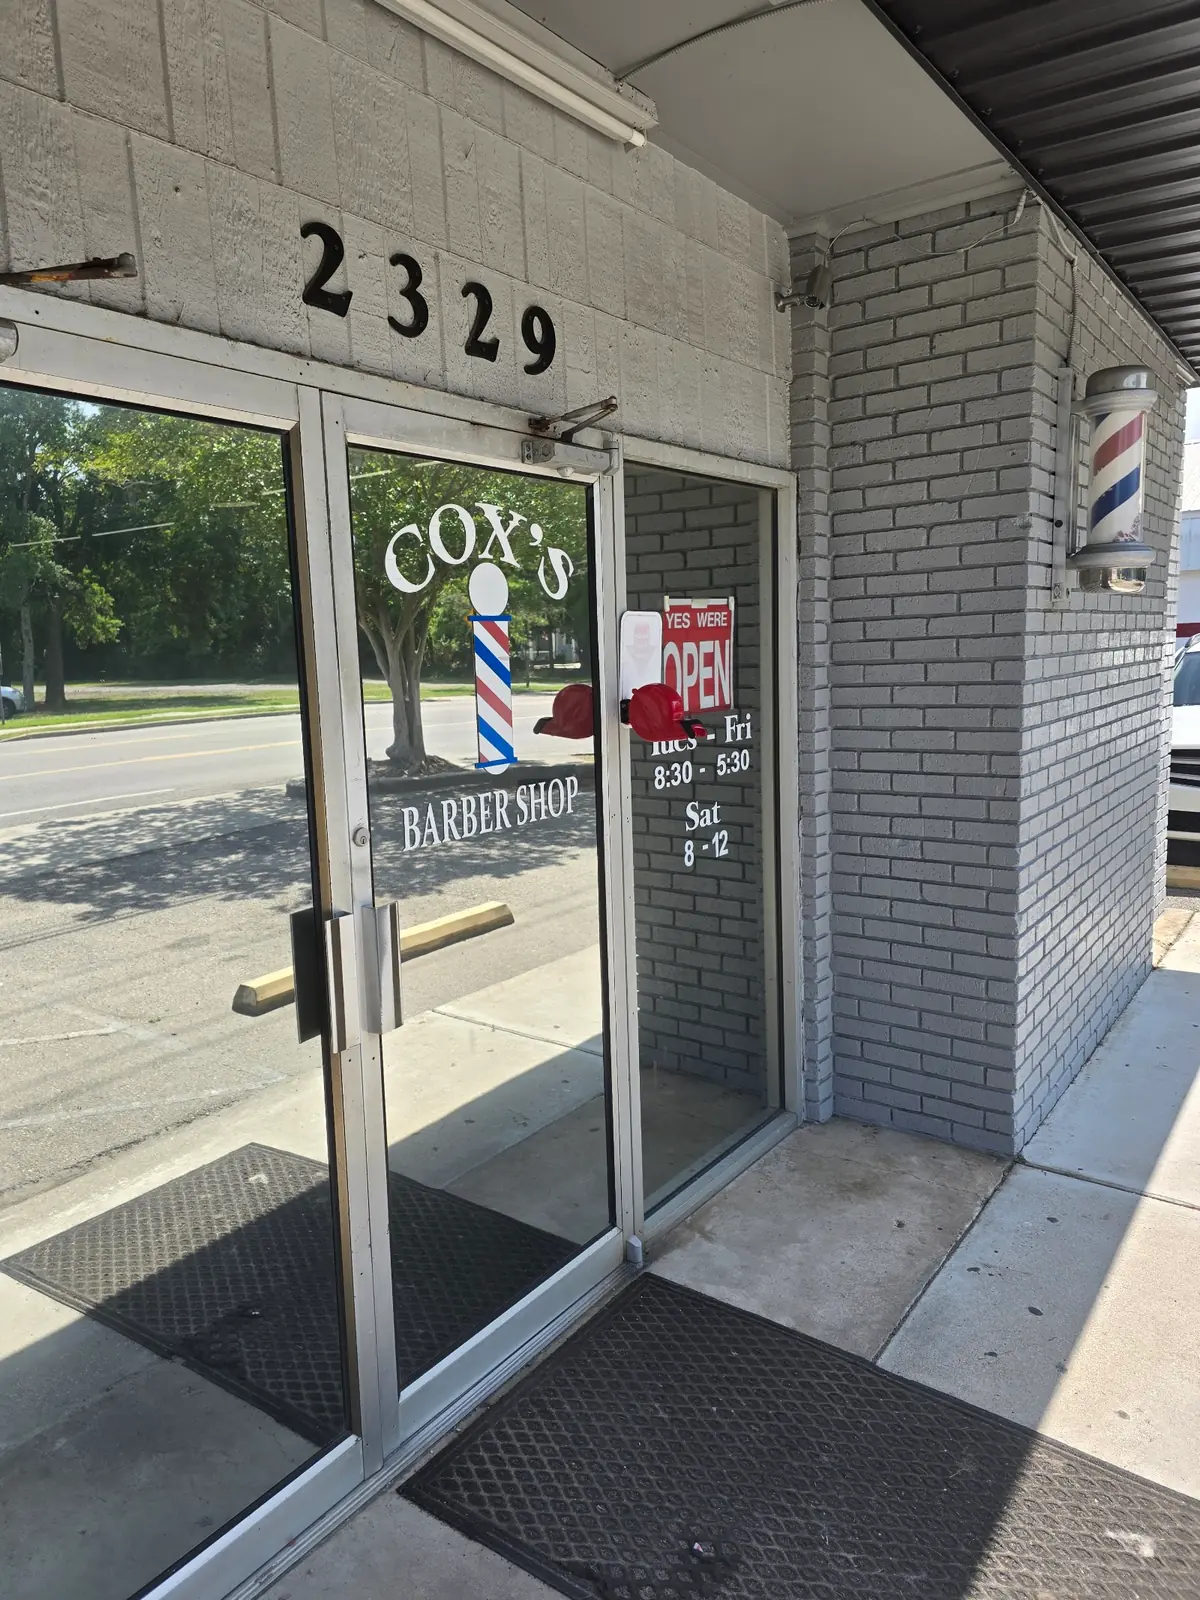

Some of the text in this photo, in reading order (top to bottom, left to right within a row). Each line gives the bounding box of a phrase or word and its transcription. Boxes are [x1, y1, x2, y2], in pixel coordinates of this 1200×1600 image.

[301, 222, 556, 375] 2329
[385, 502, 574, 600] COX'S
[666, 611, 728, 629] YES WERE
[663, 639, 731, 712] OPEN
[724, 713, 753, 743] Fri
[654, 760, 693, 790] 8:30
[716, 748, 750, 776] 5:30
[401, 775, 579, 852] BARBER SHOP
[685, 801, 721, 831] Sat
[684, 839, 695, 868] 8
